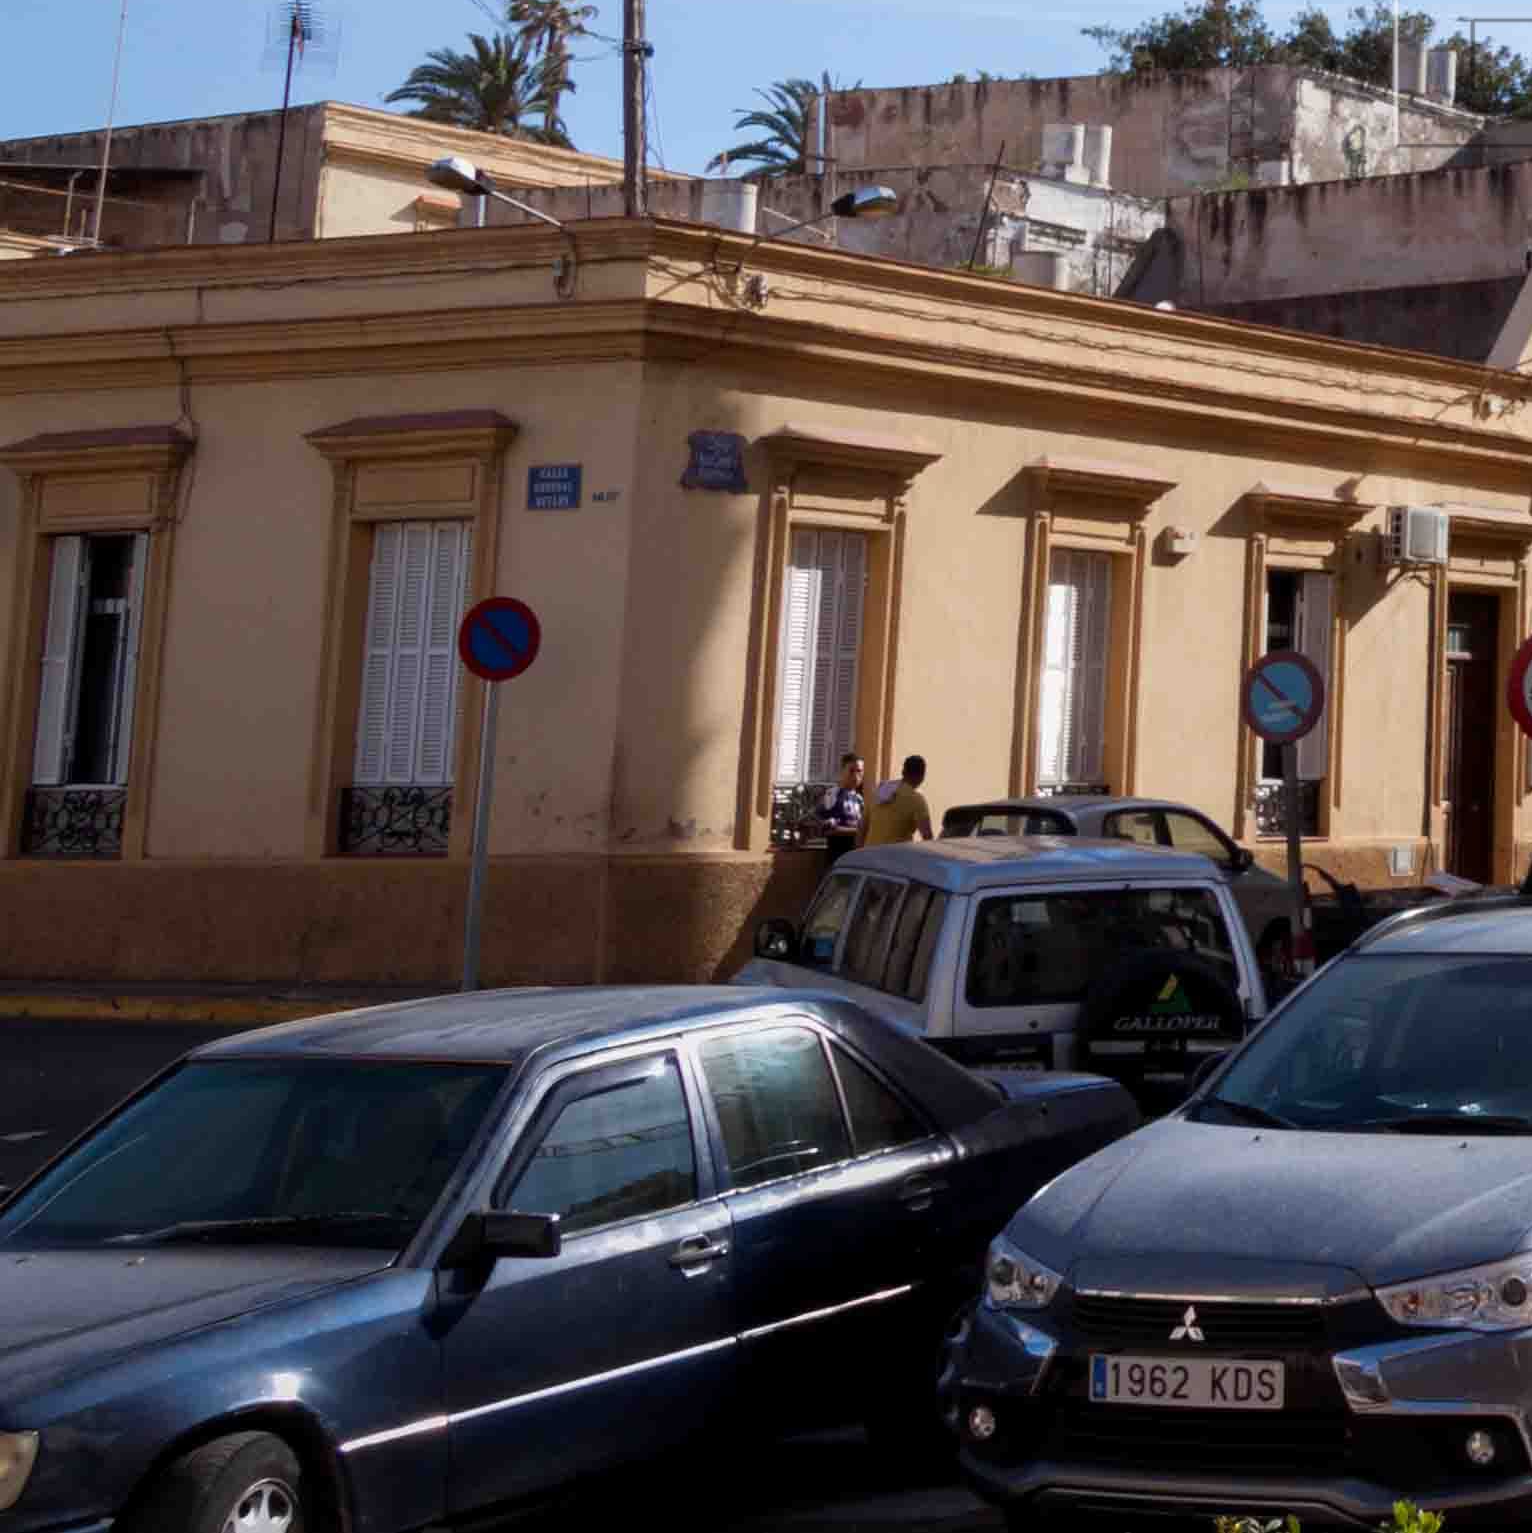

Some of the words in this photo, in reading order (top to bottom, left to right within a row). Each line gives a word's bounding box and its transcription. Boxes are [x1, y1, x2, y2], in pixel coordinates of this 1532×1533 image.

[1113, 1016, 1220, 1031] GALLOPER
[1111, 1362, 1190, 1400] 1962
[1210, 1365, 1276, 1402] KDS
